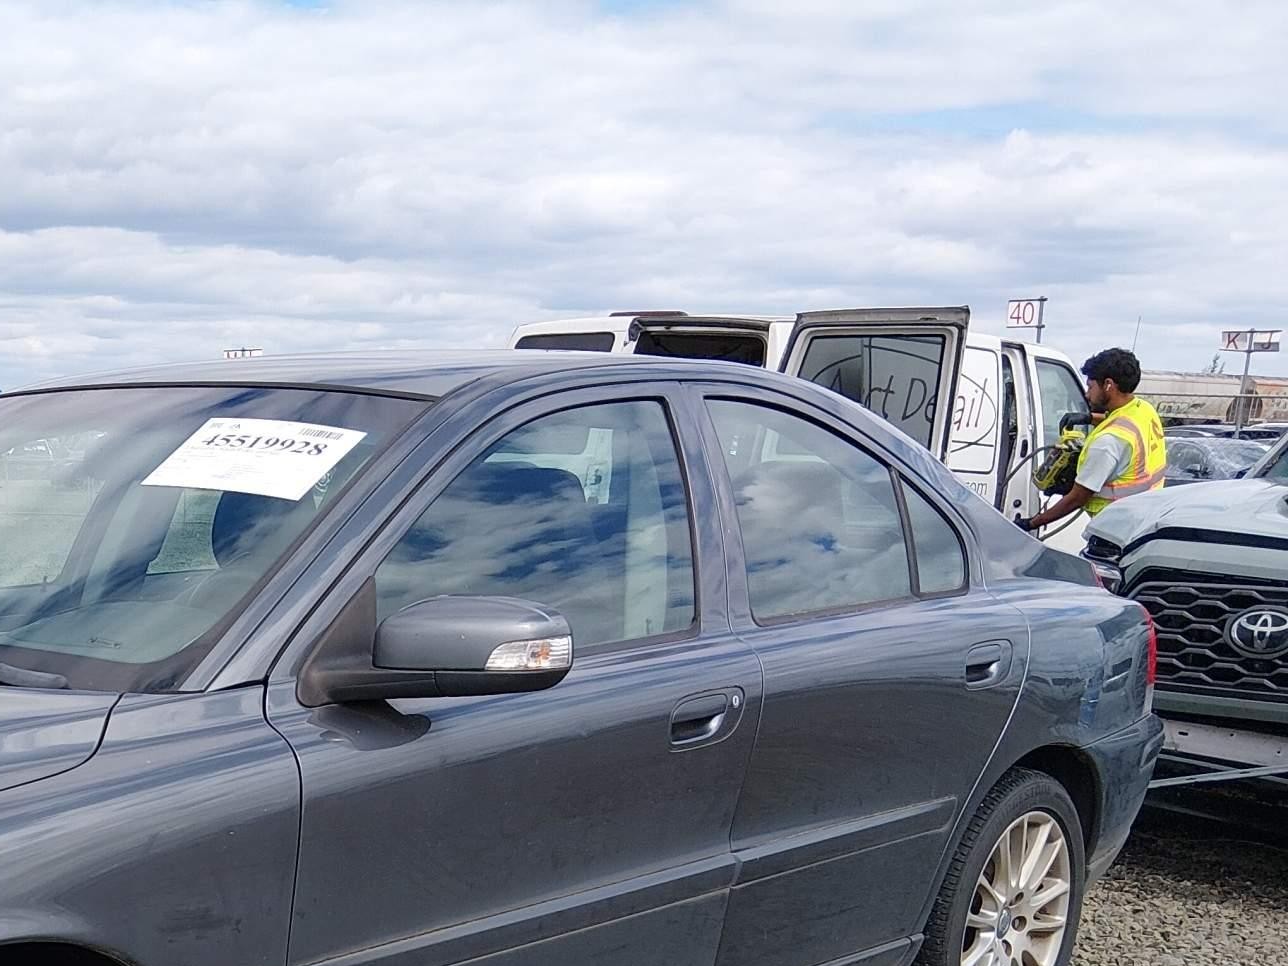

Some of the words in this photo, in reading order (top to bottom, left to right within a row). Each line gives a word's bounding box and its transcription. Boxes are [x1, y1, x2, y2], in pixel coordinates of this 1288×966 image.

[1010, 302, 1034, 325] 40
[1226, 332, 1241, 349] K
[201, 433, 329, 456] 45519928
